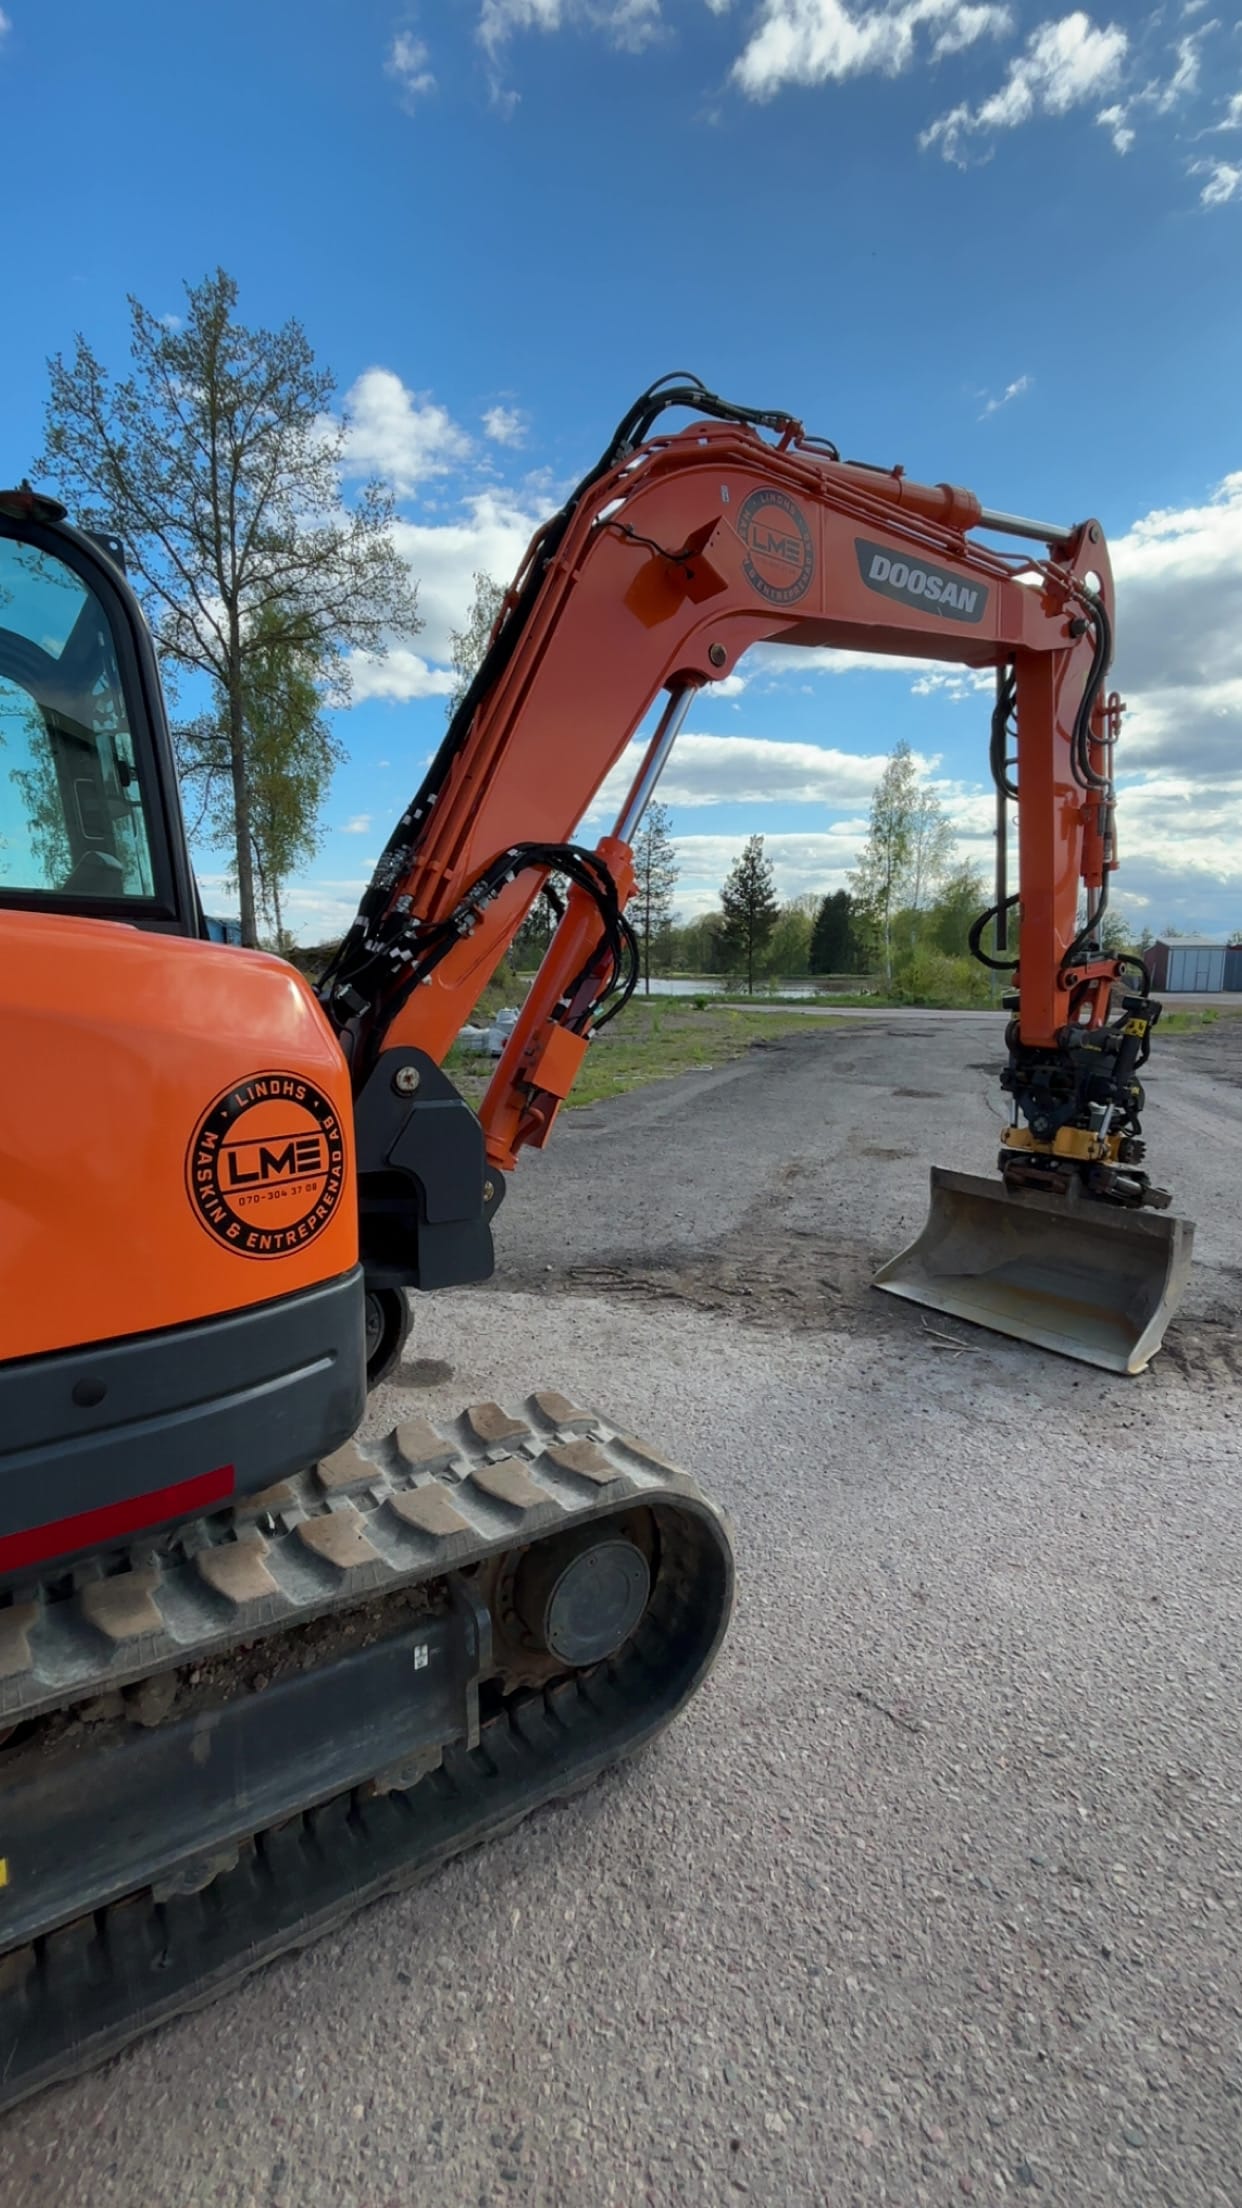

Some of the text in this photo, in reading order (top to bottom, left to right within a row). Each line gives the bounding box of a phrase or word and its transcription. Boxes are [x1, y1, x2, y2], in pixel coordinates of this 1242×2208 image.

[752, 526, 800, 561] LME
[868, 554, 978, 613] DOOSAN
[234, 1080, 306, 1107] LINDHS
[197, 1115, 341, 1249] MASKIN & ENTREPRENAD AB
[227, 1138, 321, 1185] LME
[238, 1190, 287, 1206] 070-304
[291, 1185, 302, 1195] 37
